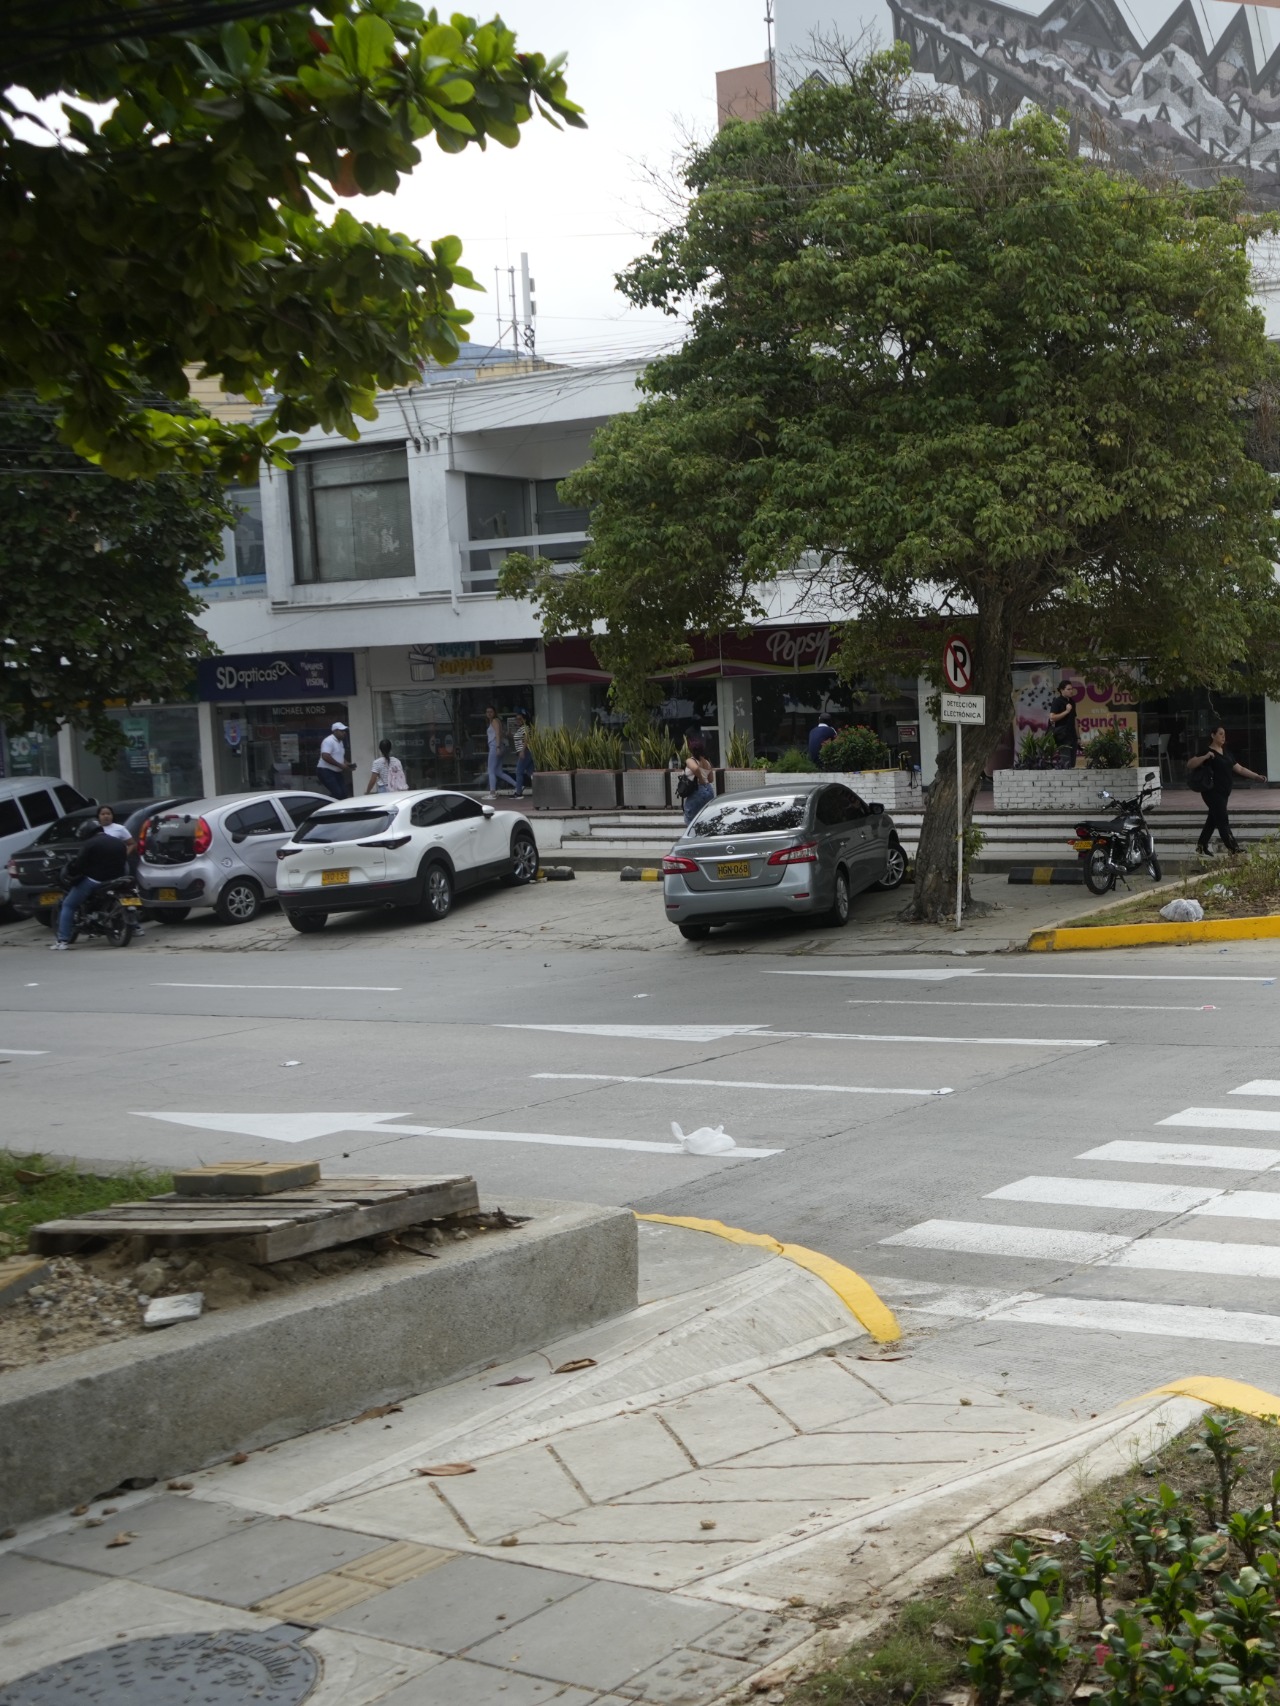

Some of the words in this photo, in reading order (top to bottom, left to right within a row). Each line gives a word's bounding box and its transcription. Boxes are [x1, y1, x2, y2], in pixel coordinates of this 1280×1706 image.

[766, 629, 831, 673] Popsy
[272, 706, 304, 716] MICHAEL
[306, 705, 326, 714] KORS
